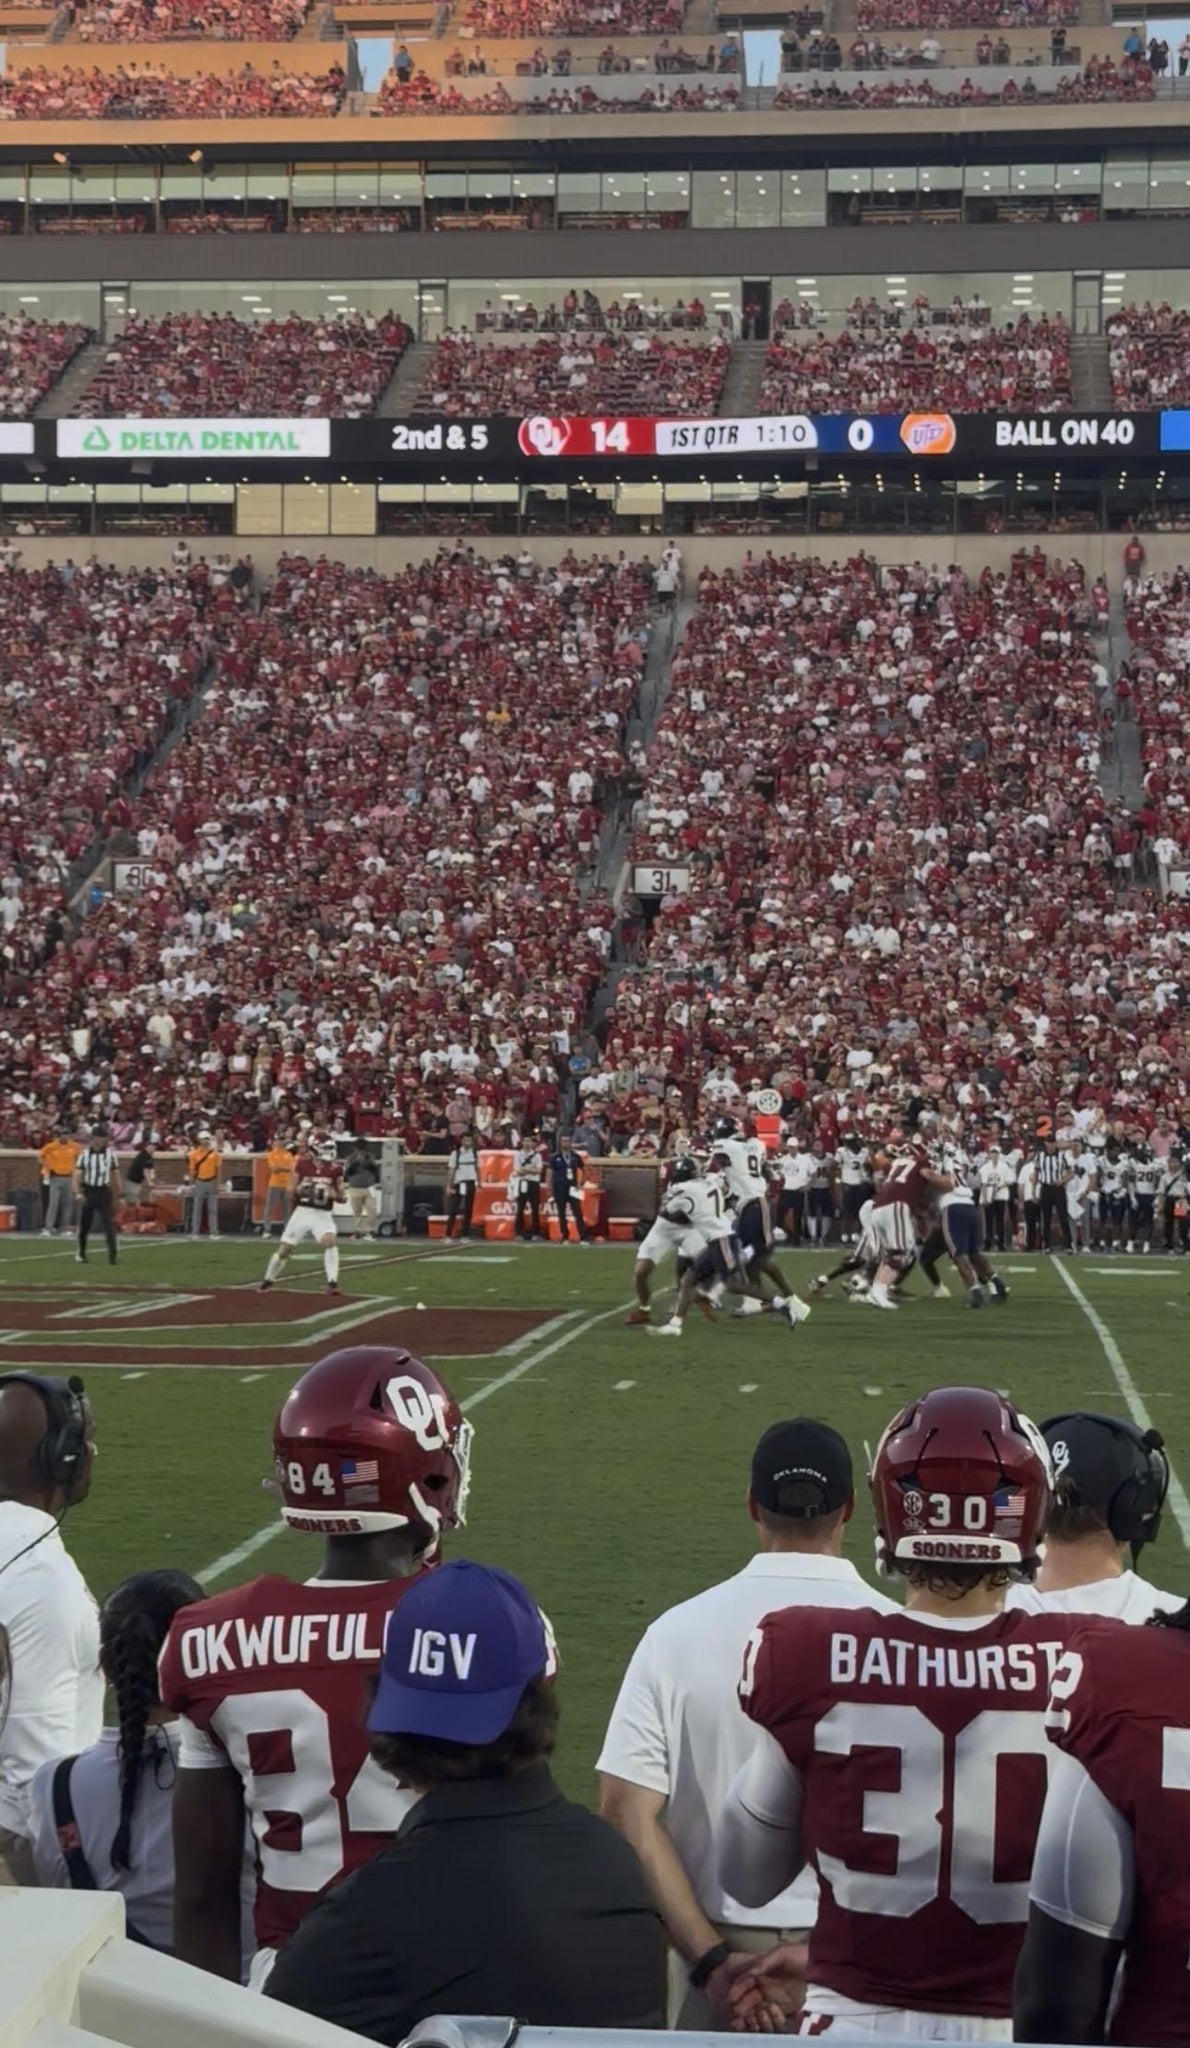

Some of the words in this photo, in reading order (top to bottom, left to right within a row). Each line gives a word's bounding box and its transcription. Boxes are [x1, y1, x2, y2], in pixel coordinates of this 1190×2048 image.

[120, 431, 194, 450] DELTA
[201, 431, 300, 450] DENTAL
[391, 424, 443, 450] 2nd
[445, 425, 466, 450] &
[470, 425, 489, 450] 5
[591, 421, 630, 452] 14
[670, 428, 698, 448] 1ST
[704, 426, 739, 447] QTR
[756, 425, 807, 443] 1:10
[848, 419, 874, 451] 0
[996, 420, 1057, 446] BALL
[1060, 419, 1098, 446] ON
[1100, 419, 1135, 446] 40
[652, 870, 671, 892] 31
[1036, 1115, 1053, 1137] 2
[747, 1154, 760, 1178] 9
[885, 1157, 917, 1184] 77
[707, 1188, 720, 1218] 7
[386, 1375, 449, 1451] OU
[288, 1462, 336, 1496] 84
[773, 1467, 827, 1483] OKLAHOMA
[928, 1493, 987, 1530] 30
[912, 1541, 1002, 1560] SOONERS
[181, 1610, 393, 1679] OKWUFUL
[409, 1628, 477, 1680] IGV
[831, 1633, 1063, 1691] BATHURST
[814, 1702, 1049, 1925] 30
